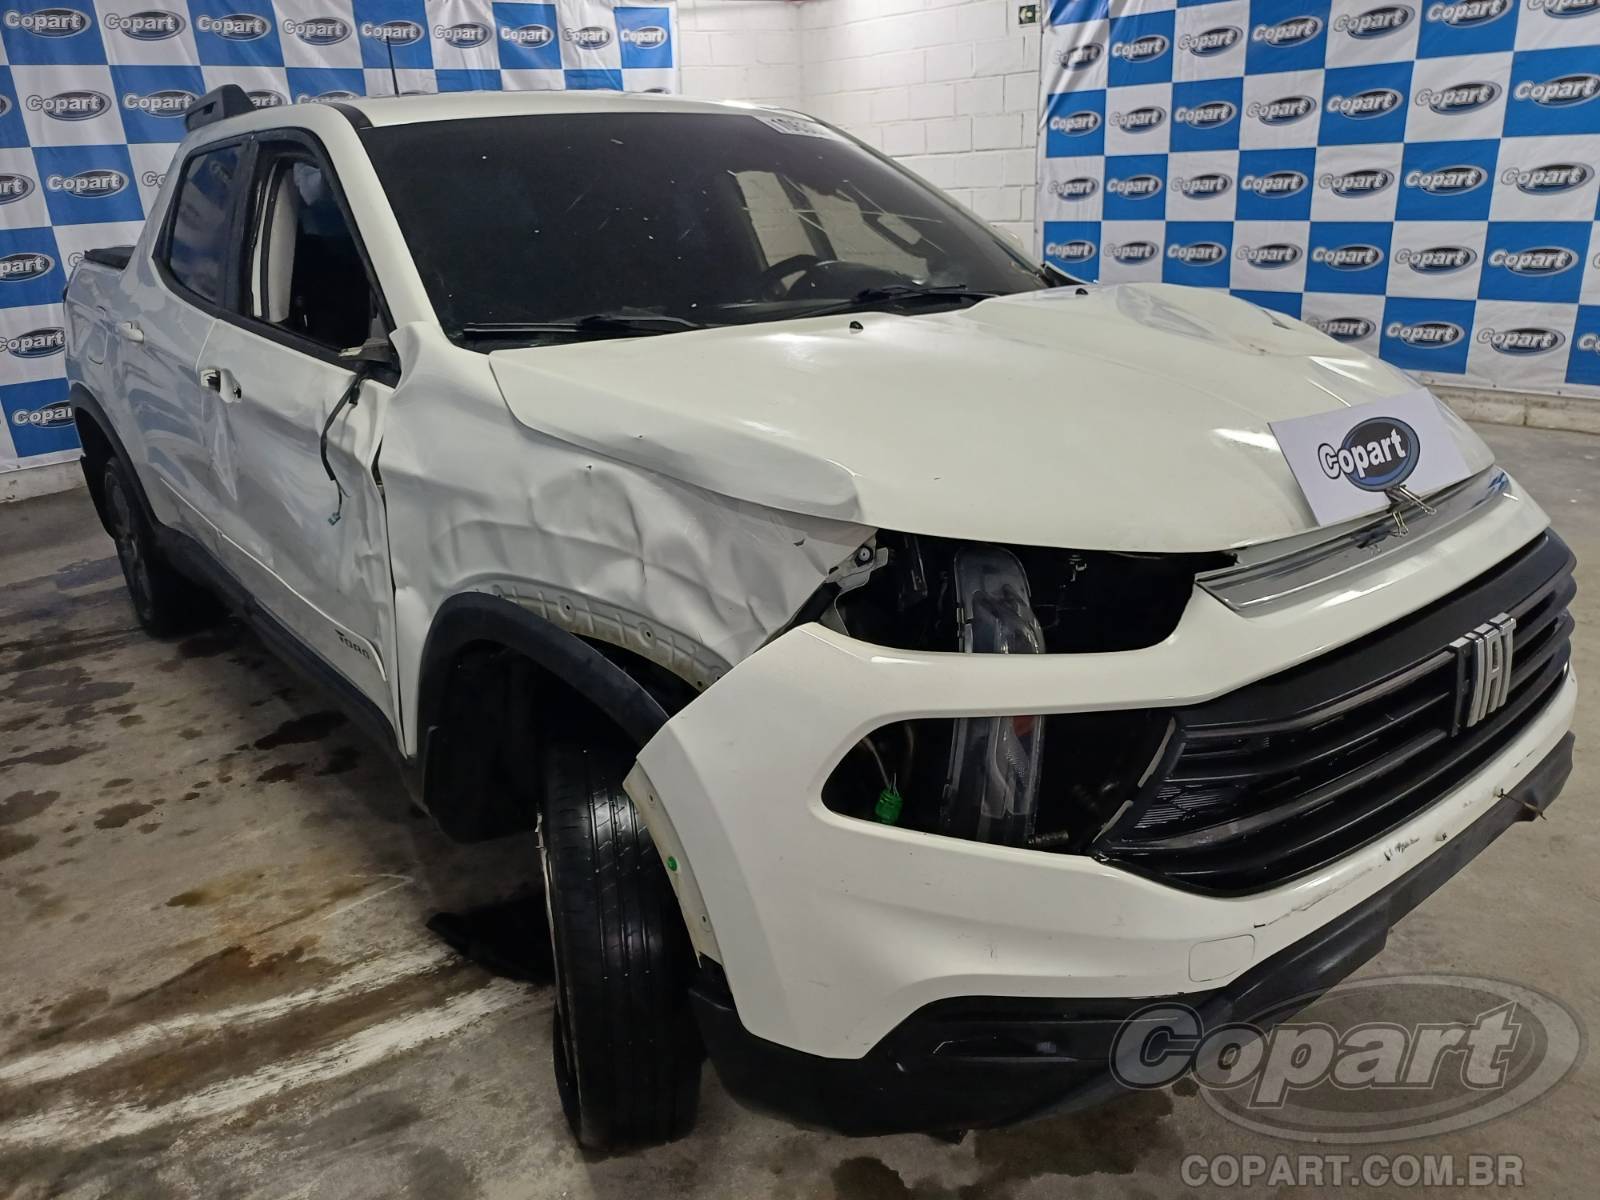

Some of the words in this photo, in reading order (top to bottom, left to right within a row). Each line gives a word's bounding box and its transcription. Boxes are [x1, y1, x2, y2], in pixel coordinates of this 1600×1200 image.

[1334, 8, 1403, 31] Copart
[1427, 0, 1500, 21] Copart
[5, 9, 81, 33] Copart
[105, 14, 175, 34] Copart
[198, 16, 261, 35] Copart
[283, 20, 342, 39] Copart
[1253, 21, 1312, 41] Copart
[361, 25, 417, 43] Copart
[434, 25, 483, 42] Copart
[501, 28, 546, 42] Copart
[565, 28, 609, 42] Copart
[621, 29, 663, 44] Copart
[1179, 31, 1233, 51] Copart
[1113, 39, 1161, 57] Copart
[1416, 85, 1489, 107] Copart
[1515, 78, 1597, 102] Copart
[27, 94, 100, 116] Copart
[123, 93, 191, 114] Copart
[1175, 103, 1228, 122] Copart
[1247, 98, 1306, 119] Copart
[1327, 92, 1393, 113] Copart
[1050, 113, 1095, 130] Copart
[1110, 109, 1160, 128] Copart
[47, 174, 121, 196] Copart
[1049, 180, 1091, 194] Copart
[1107, 176, 1156, 193] Copart
[1171, 175, 1222, 193] Copart
[1241, 172, 1299, 191] Copart
[1319, 171, 1384, 191] Copart
[1405, 168, 1477, 189] Copart
[1501, 166, 1580, 188] Copart
[1046, 242, 1088, 258] Copart
[1105, 243, 1152, 258] Copart
[1167, 243, 1219, 259] Copart
[1237, 245, 1294, 261] Copart
[1312, 246, 1375, 265] Copart
[1396, 246, 1465, 266] Copart
[1490, 249, 1569, 270] Copart
[1387, 322, 1455, 343] Copart
[1477, 327, 1552, 349] Copart
[1318, 428, 1407, 480] Copart
